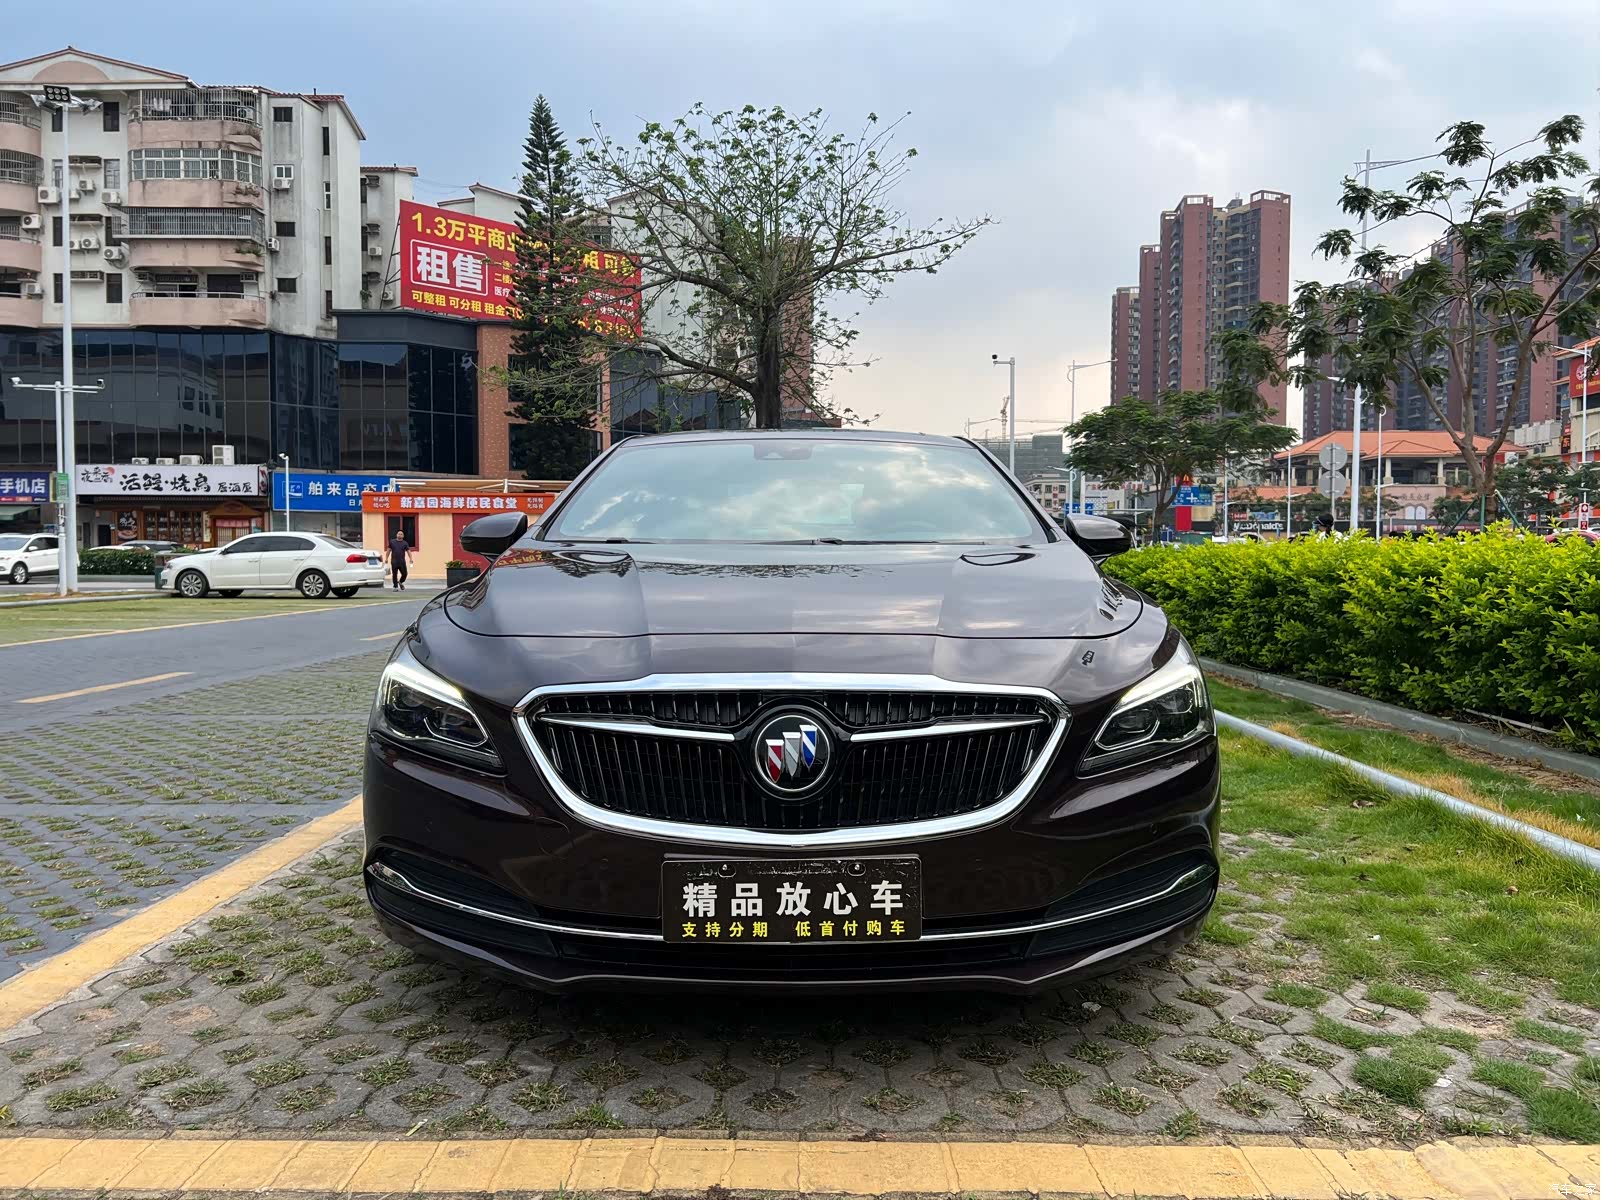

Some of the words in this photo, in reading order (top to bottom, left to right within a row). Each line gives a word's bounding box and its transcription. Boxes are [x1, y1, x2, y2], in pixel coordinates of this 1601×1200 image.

[416, 246, 484, 292] 租售
[411, 290, 446, 307] 可整租
[448, 296, 482, 313] 可分租
[0, 478, 46, 494] 手机店
[682, 880, 904, 918] 精品放心车
[682, 920, 769, 938] 支持分期
[795, 919, 906, 937] 低首付购车
